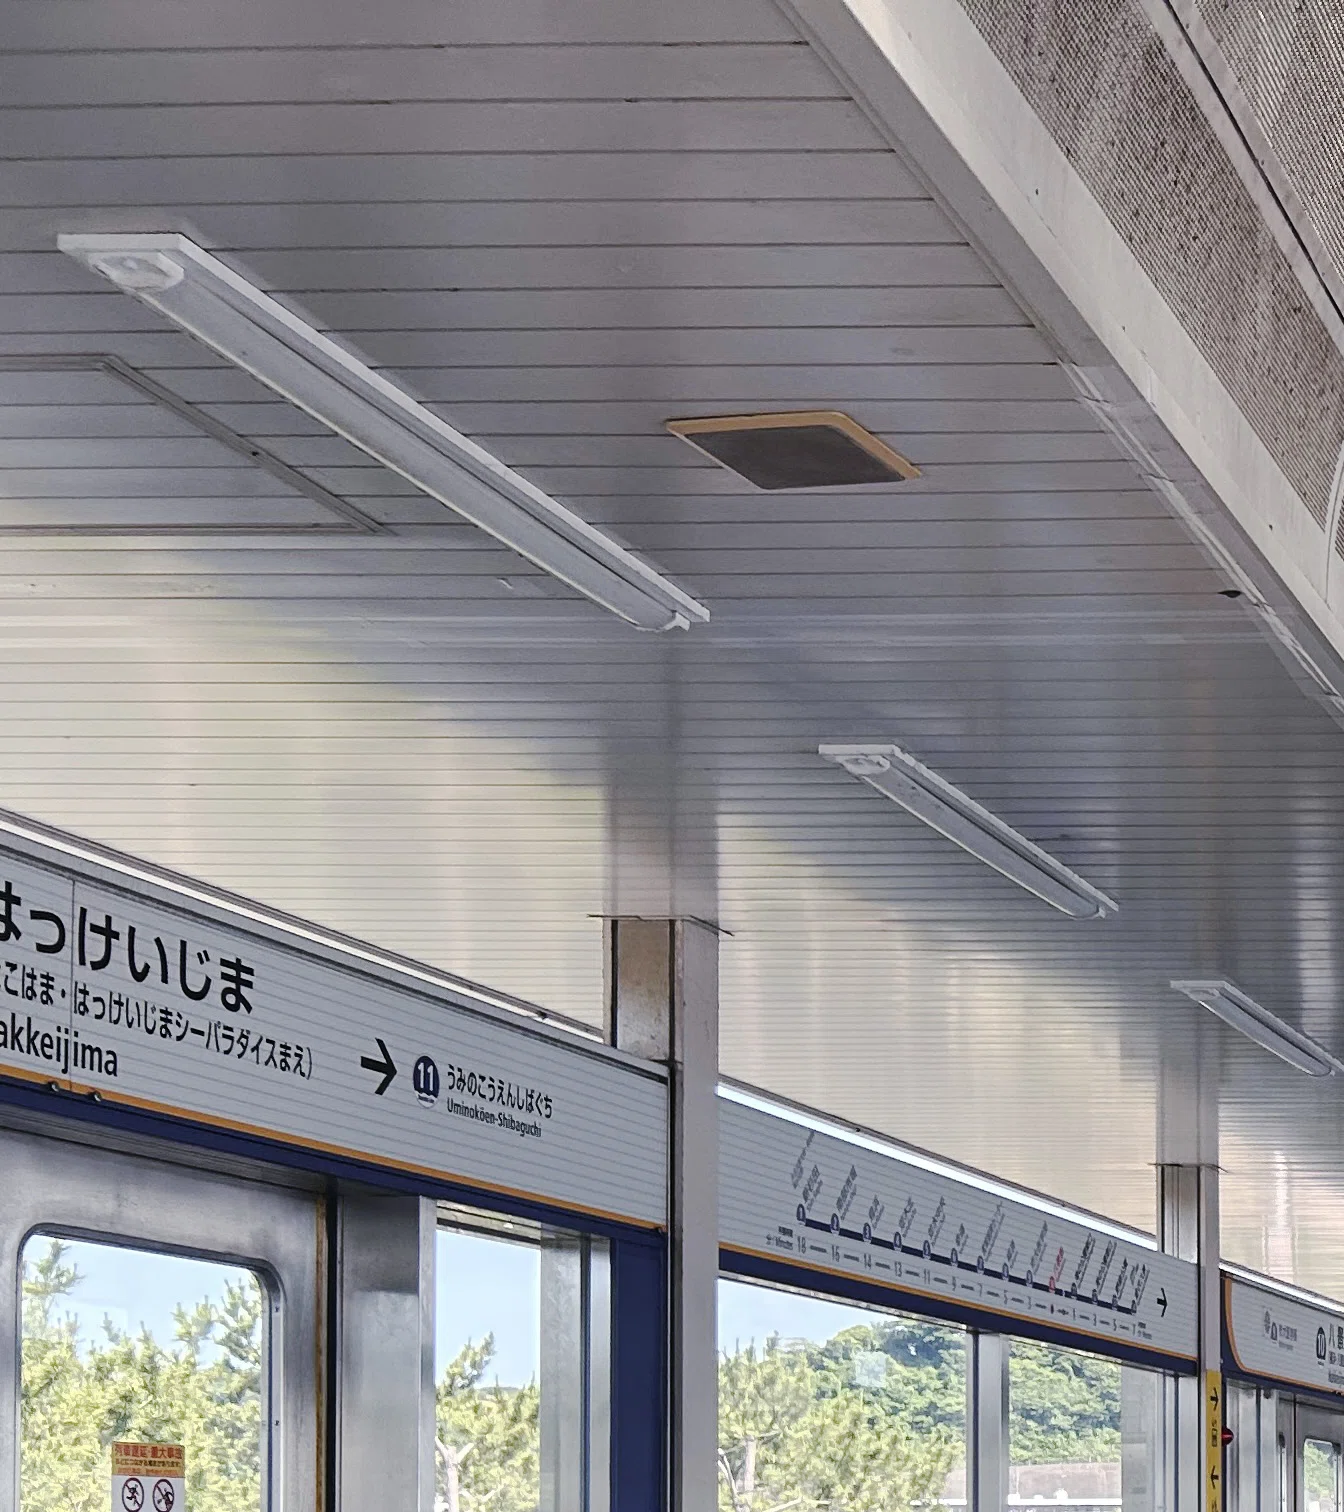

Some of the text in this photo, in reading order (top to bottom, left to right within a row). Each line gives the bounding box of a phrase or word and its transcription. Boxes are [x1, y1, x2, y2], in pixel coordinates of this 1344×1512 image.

[418, 1062, 434, 1091] 11
[447, 1063, 553, 1119] うみのこうえんしばぐち
